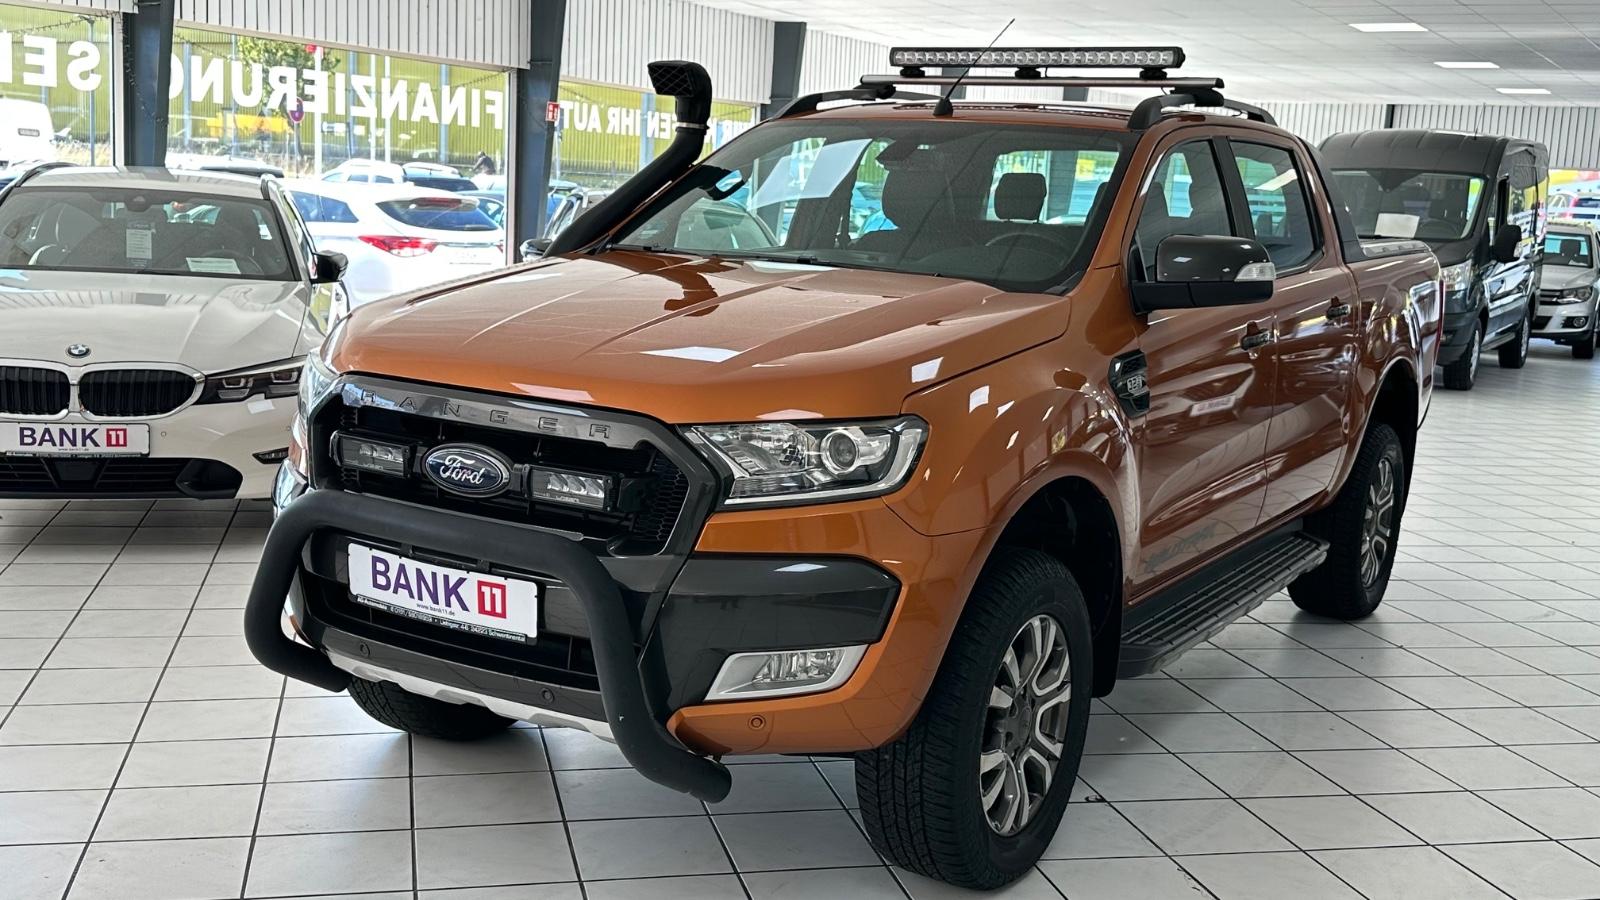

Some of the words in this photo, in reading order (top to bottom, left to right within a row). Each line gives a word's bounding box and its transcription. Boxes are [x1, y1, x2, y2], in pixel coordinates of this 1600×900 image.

[359, 388, 611, 440] RANGER
[19, 426, 101, 448] BANK
[107, 429, 125, 446] 11
[440, 455, 486, 485] Ford
[372, 556, 469, 611] BANK
[479, 584, 504, 616] 11
